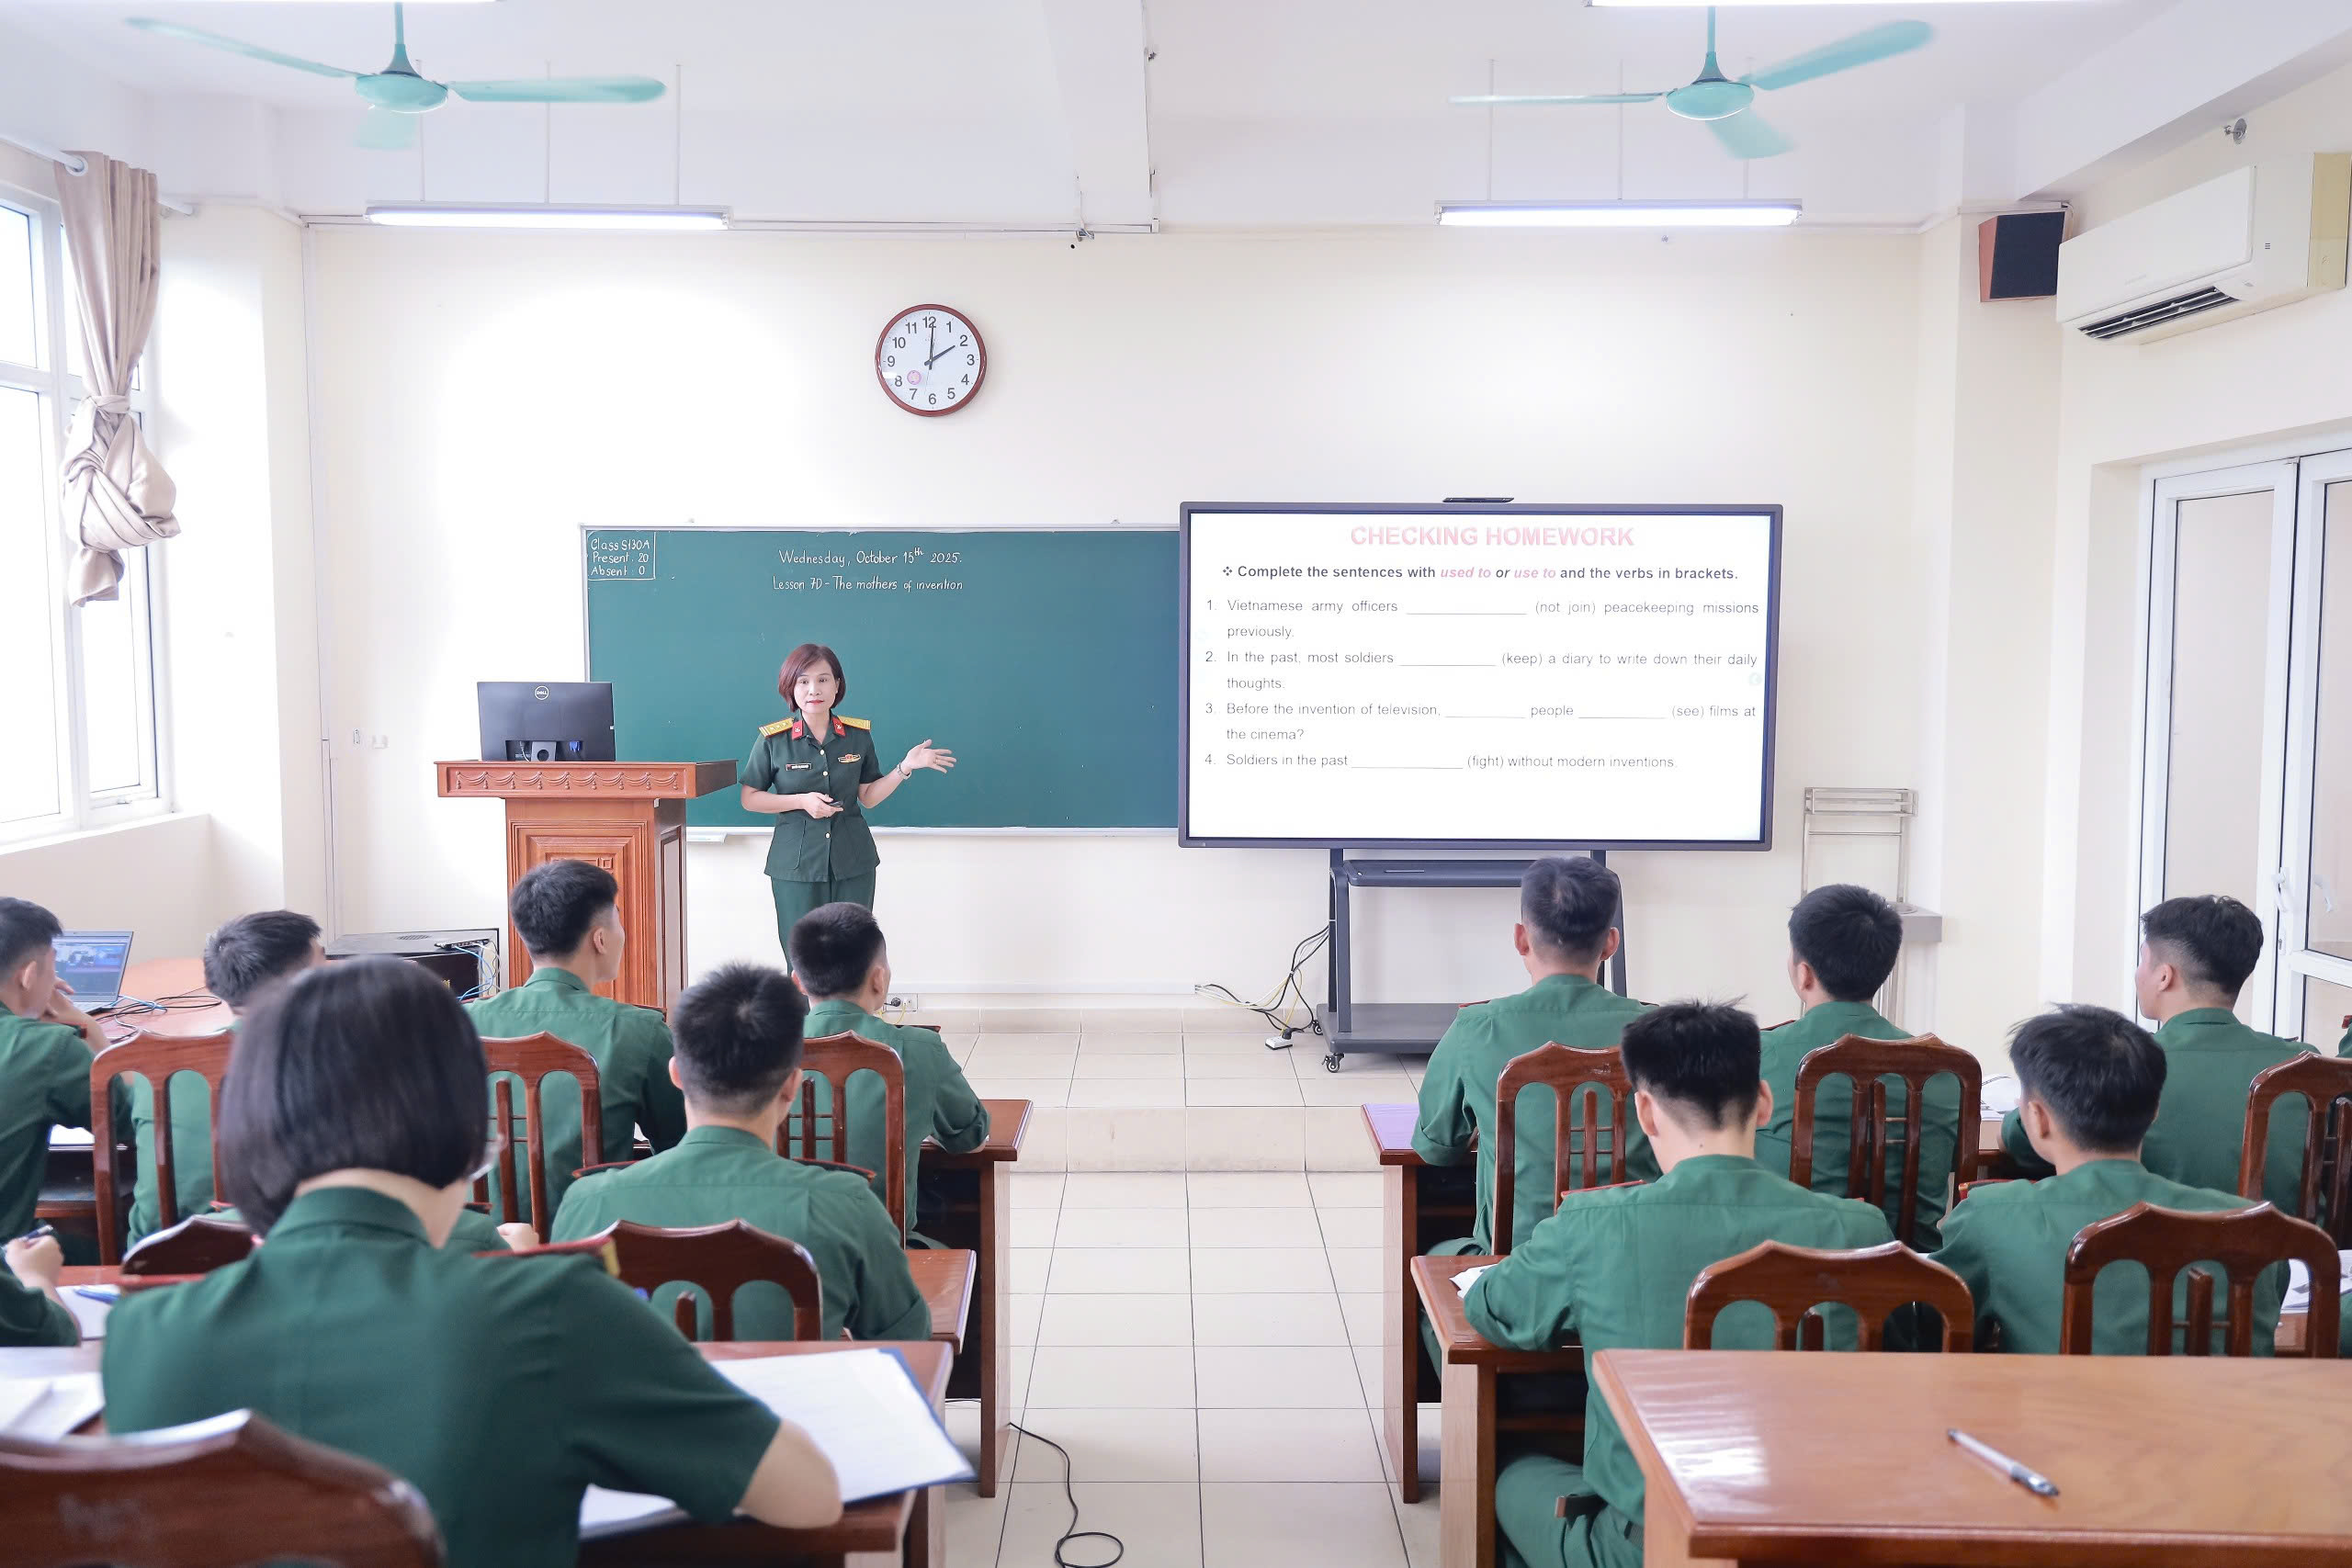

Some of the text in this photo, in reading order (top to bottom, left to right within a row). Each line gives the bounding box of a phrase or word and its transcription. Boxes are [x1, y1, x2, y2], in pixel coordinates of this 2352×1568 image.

[905, 321, 917, 334] 11
[922, 316, 936, 329] 12
[946, 321, 952, 333] 1
[892, 336, 906, 349] 10
[959, 334, 968, 347] 2
[887, 355, 896, 367] 9
[967, 354, 975, 367] 3
[894, 375, 903, 388] 8
[961, 373, 969, 386] 4
[909, 388, 918, 400] 7
[928, 392, 937, 405] 6
[947, 387, 956, 400] 5
[1351, 525, 1634, 547] CHECKING HOMEWORK
[591, 537, 619, 551] Class
[638, 552, 650, 563] 20
[778, 549, 851, 568] Wednesday,
[856, 549, 899, 564] October
[930, 552, 963, 564] 2025.
[639, 565, 645, 575] 0
[1237, 566, 1738, 581] Complete the sentences with used to or use to and the verbs in brackets.
[773, 575, 805, 590] Lesson
[831, 575, 853, 590] The
[856, 575, 898, 590] mothers
[903, 581, 912, 592] of
[916, 578, 963, 590] invention
[1206, 599, 1759, 616] 1. Vietnamese army officers (not join) peacekeeping missions
[1227, 626, 1295, 640] previously.
[1205, 650, 1758, 668] 2. In the past, most soldiers (keep) a diary to write down their daily
[1227, 678, 1285, 692] thoughts.
[1227, 702, 1269, 715] Before
[1273, 703, 1294, 715] the
[1298, 704, 1356, 716] invention
[1360, 703, 1374, 716] of
[1377, 704, 1442, 716] television,
[1530, 705, 1574, 719] people
[1671, 705, 1705, 720] (see)
[1709, 705, 1739, 717] films
[1744, 705, 1757, 717] at
[1227, 728, 1305, 740] the cinema?
[1227, 753, 1278, 766] Soldiers
[1282, 754, 1292, 766] in
[1296, 754, 1317, 766] the
[1320, 754, 1348, 769] past
[1467, 755, 1504, 770] (fight)
[1508, 756, 1554, 768] without
[1557, 756, 1605, 768] modern
[1610, 756, 1678, 768] inventions.
